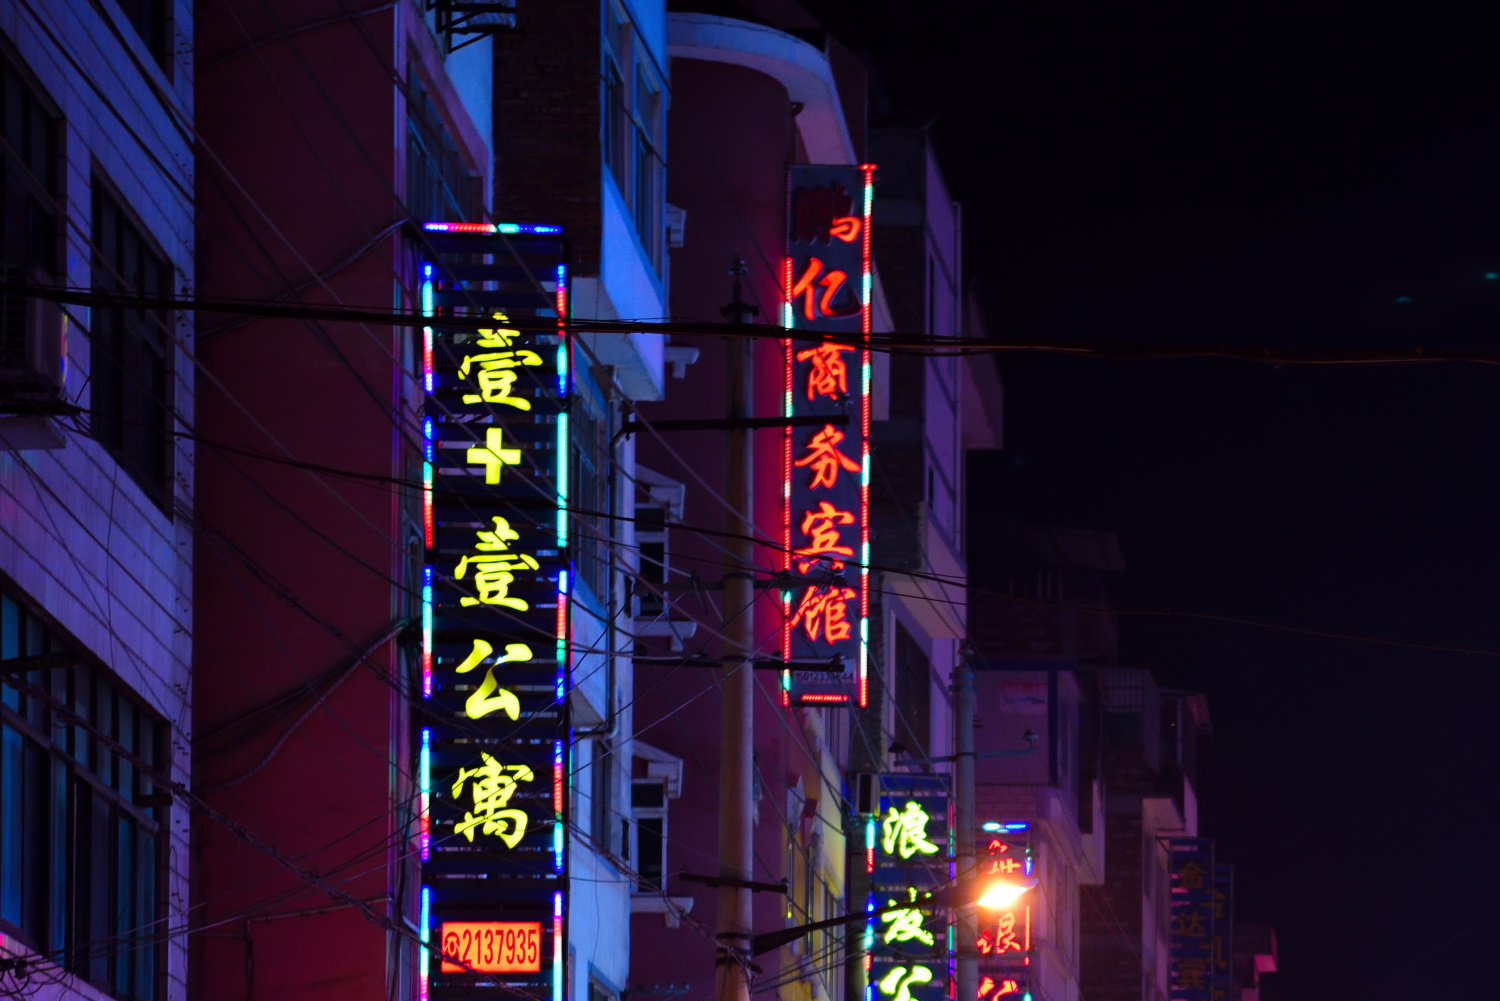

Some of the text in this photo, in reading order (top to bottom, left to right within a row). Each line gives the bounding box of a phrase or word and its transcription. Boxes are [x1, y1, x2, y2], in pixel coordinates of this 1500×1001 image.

[452, 311, 543, 849] 壹十壹公寓
[462, 929, 538, 966] 2137935
